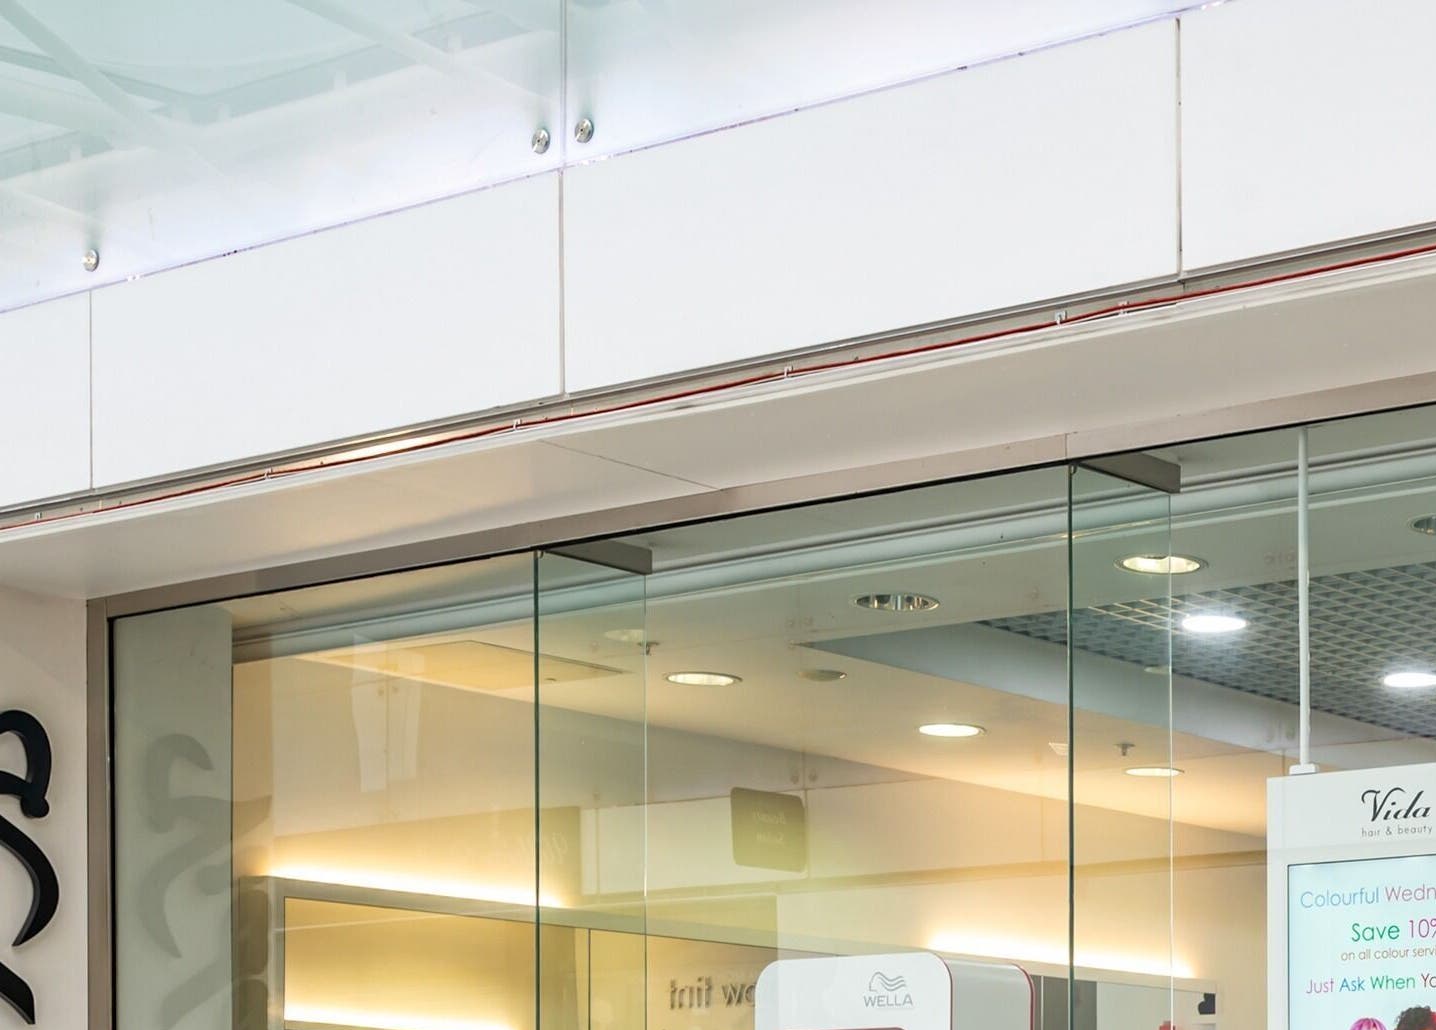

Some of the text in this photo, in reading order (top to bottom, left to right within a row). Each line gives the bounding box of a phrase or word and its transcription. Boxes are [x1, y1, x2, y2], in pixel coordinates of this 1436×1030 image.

[1361, 786, 1432, 822] Vida
[1361, 823, 1433, 838] hair & beauty
[1300, 886, 1380, 909] Colourful
[1351, 922, 1401, 942] Save
[1340, 952, 1356, 962] on
[1358, 948, 1371, 961] all
[1373, 948, 1410, 960] colour
[1305, 978, 1335, 994] Just
[1338, 976, 1367, 992] Ask
[1370, 974, 1417, 990] When
[863, 993, 914, 1008] WELLA
